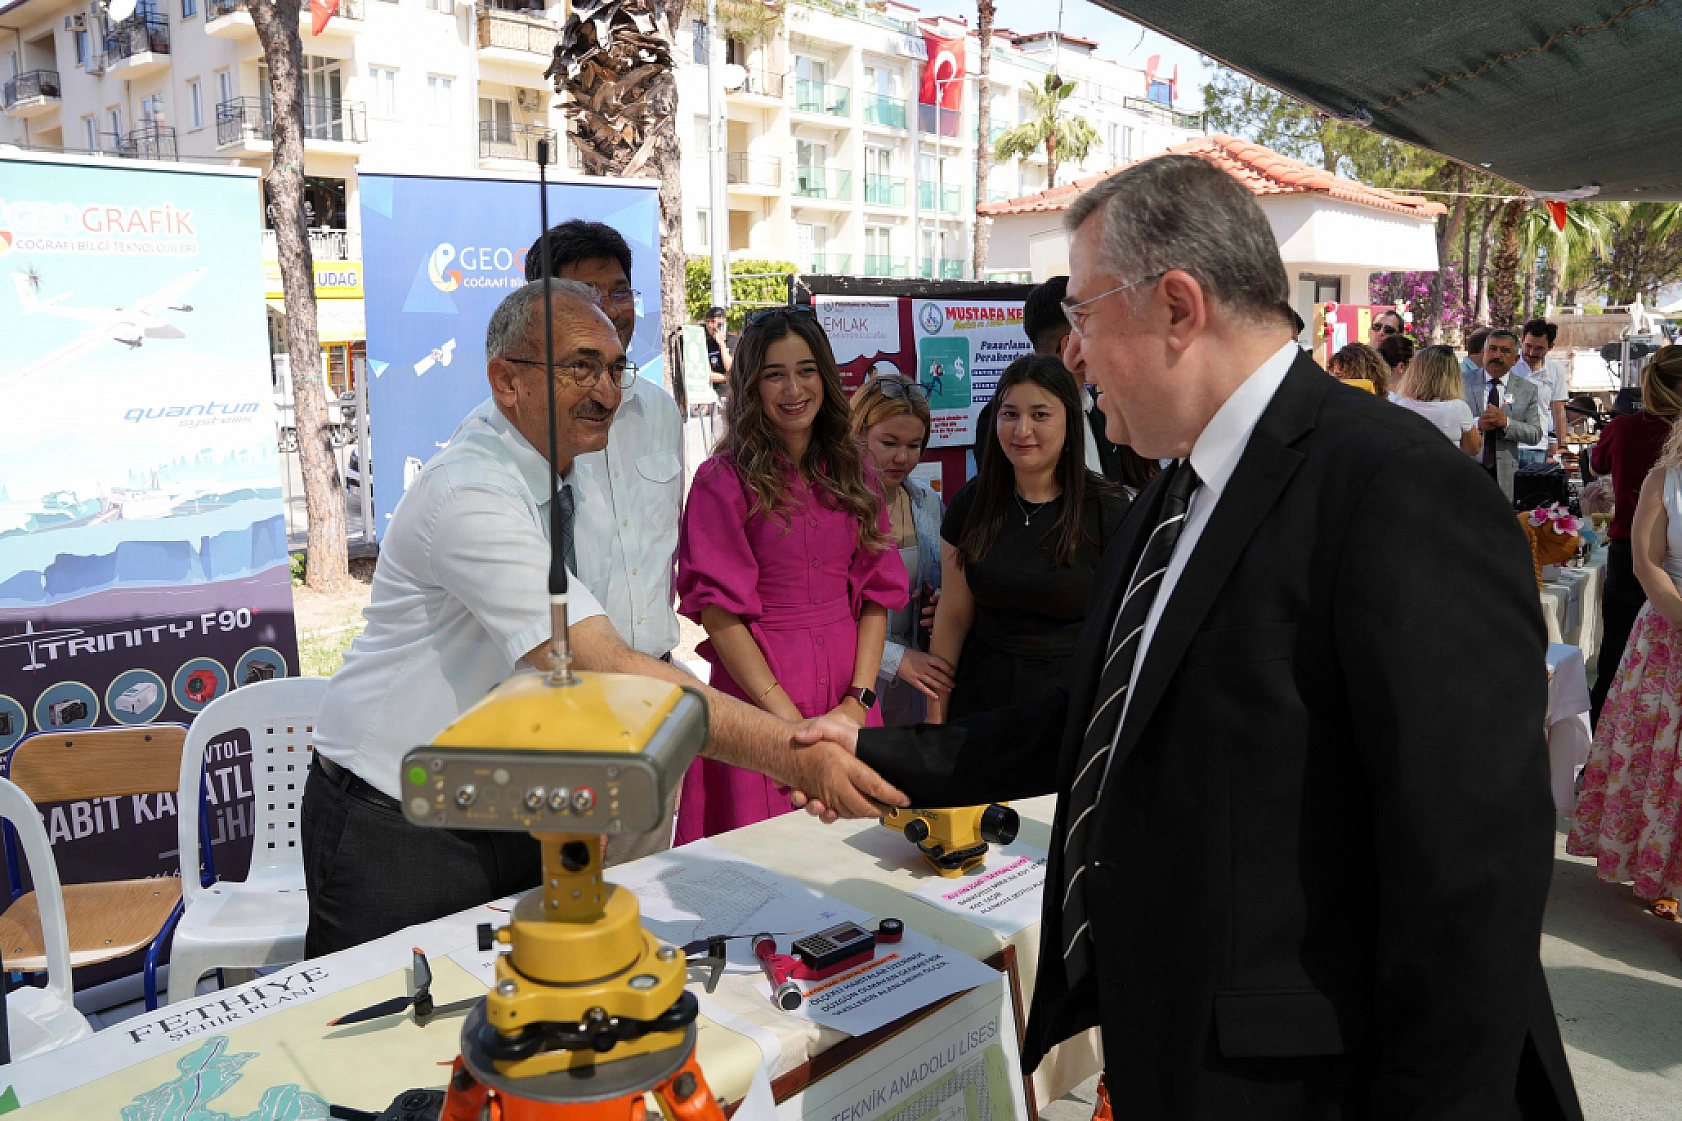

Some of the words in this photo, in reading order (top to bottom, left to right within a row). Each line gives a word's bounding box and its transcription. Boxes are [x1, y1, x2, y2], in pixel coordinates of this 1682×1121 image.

[313, 271, 358, 287] UDAĞ
[823, 317, 869, 332] EMLAK
[124, 401, 259, 424] quantum
[39, 620, 194, 660] TRINITY
[889, 1043, 956, 1100] ANADOLU
